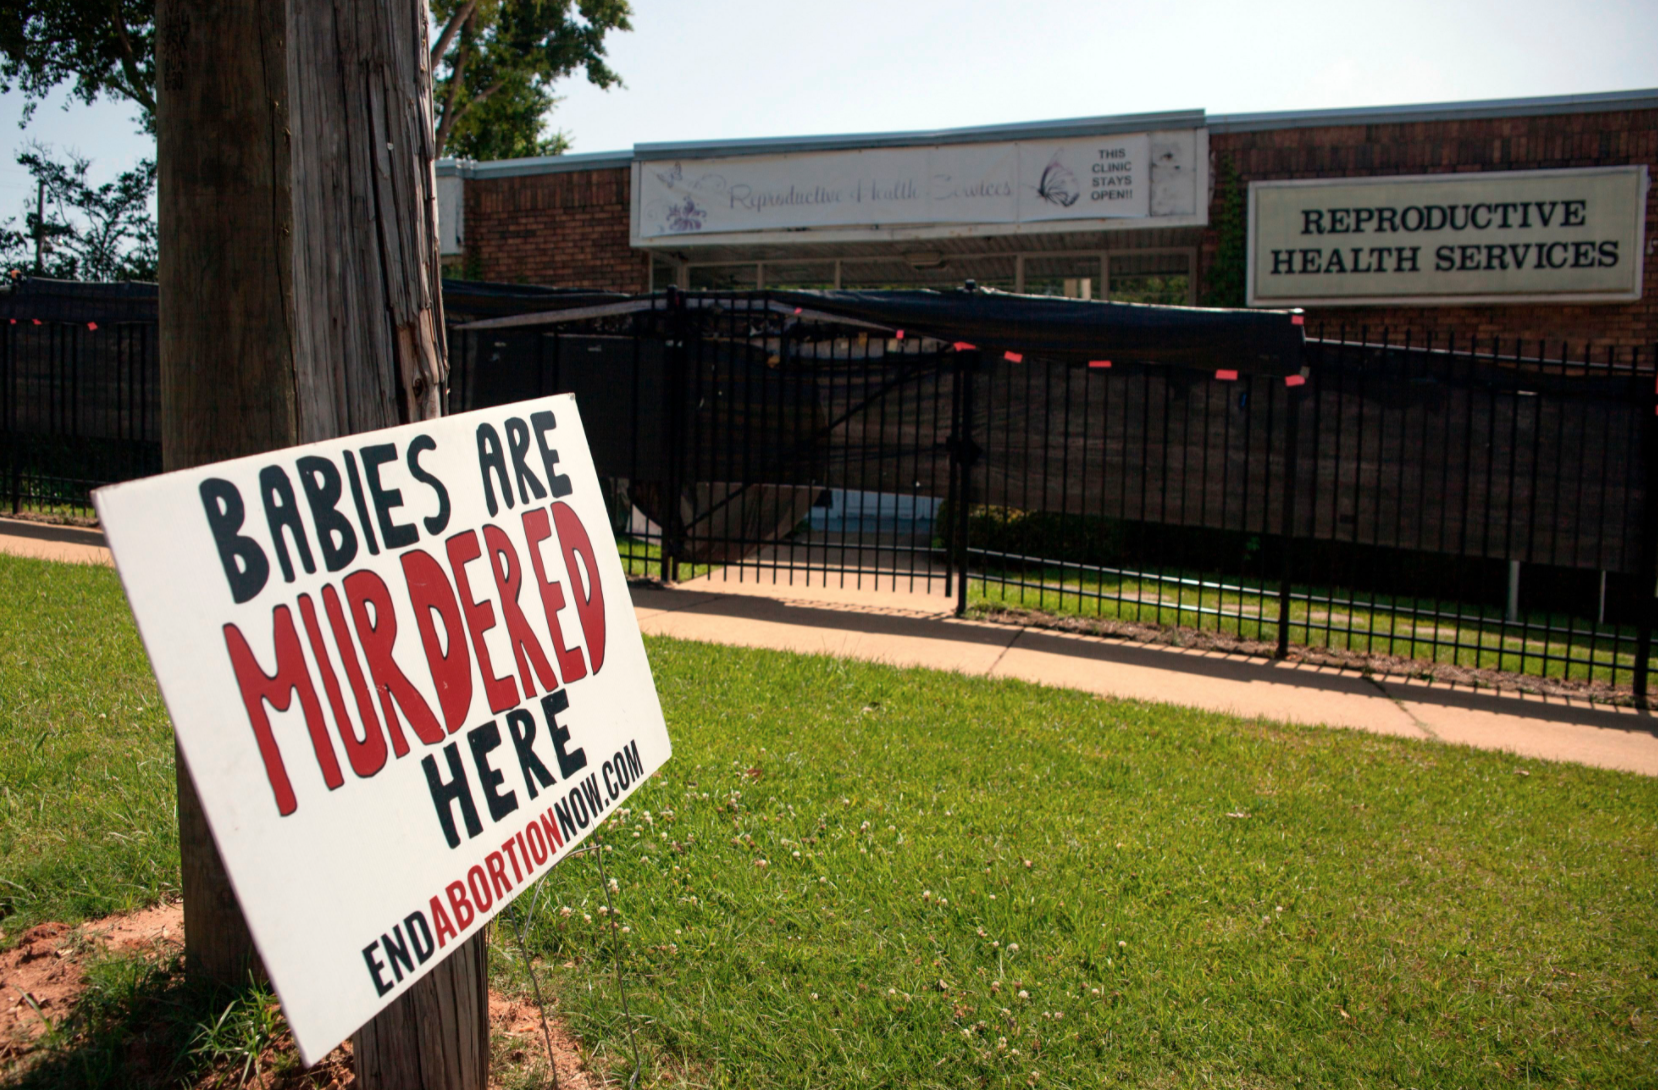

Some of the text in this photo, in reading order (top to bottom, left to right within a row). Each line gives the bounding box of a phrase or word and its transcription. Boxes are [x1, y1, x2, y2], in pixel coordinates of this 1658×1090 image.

[1092, 161, 1132, 173] CLINIC
[1099, 148, 1126, 159] THIS
[729, 183, 842, 213] Reproductive
[1091, 189, 1133, 201] OPEN!!
[1092, 175, 1132, 187] STAYS
[1300, 200, 1586, 234] REPRODUCTIVE
[1270, 240, 1619, 274] HEALTH SERVICES
[199, 411, 574, 604] BABIES ARE
[222, 501, 606, 817] MURDERED
[421, 688, 588, 850] HERE
[361, 739, 644, 998] ENDABORTIONNOW.COM
